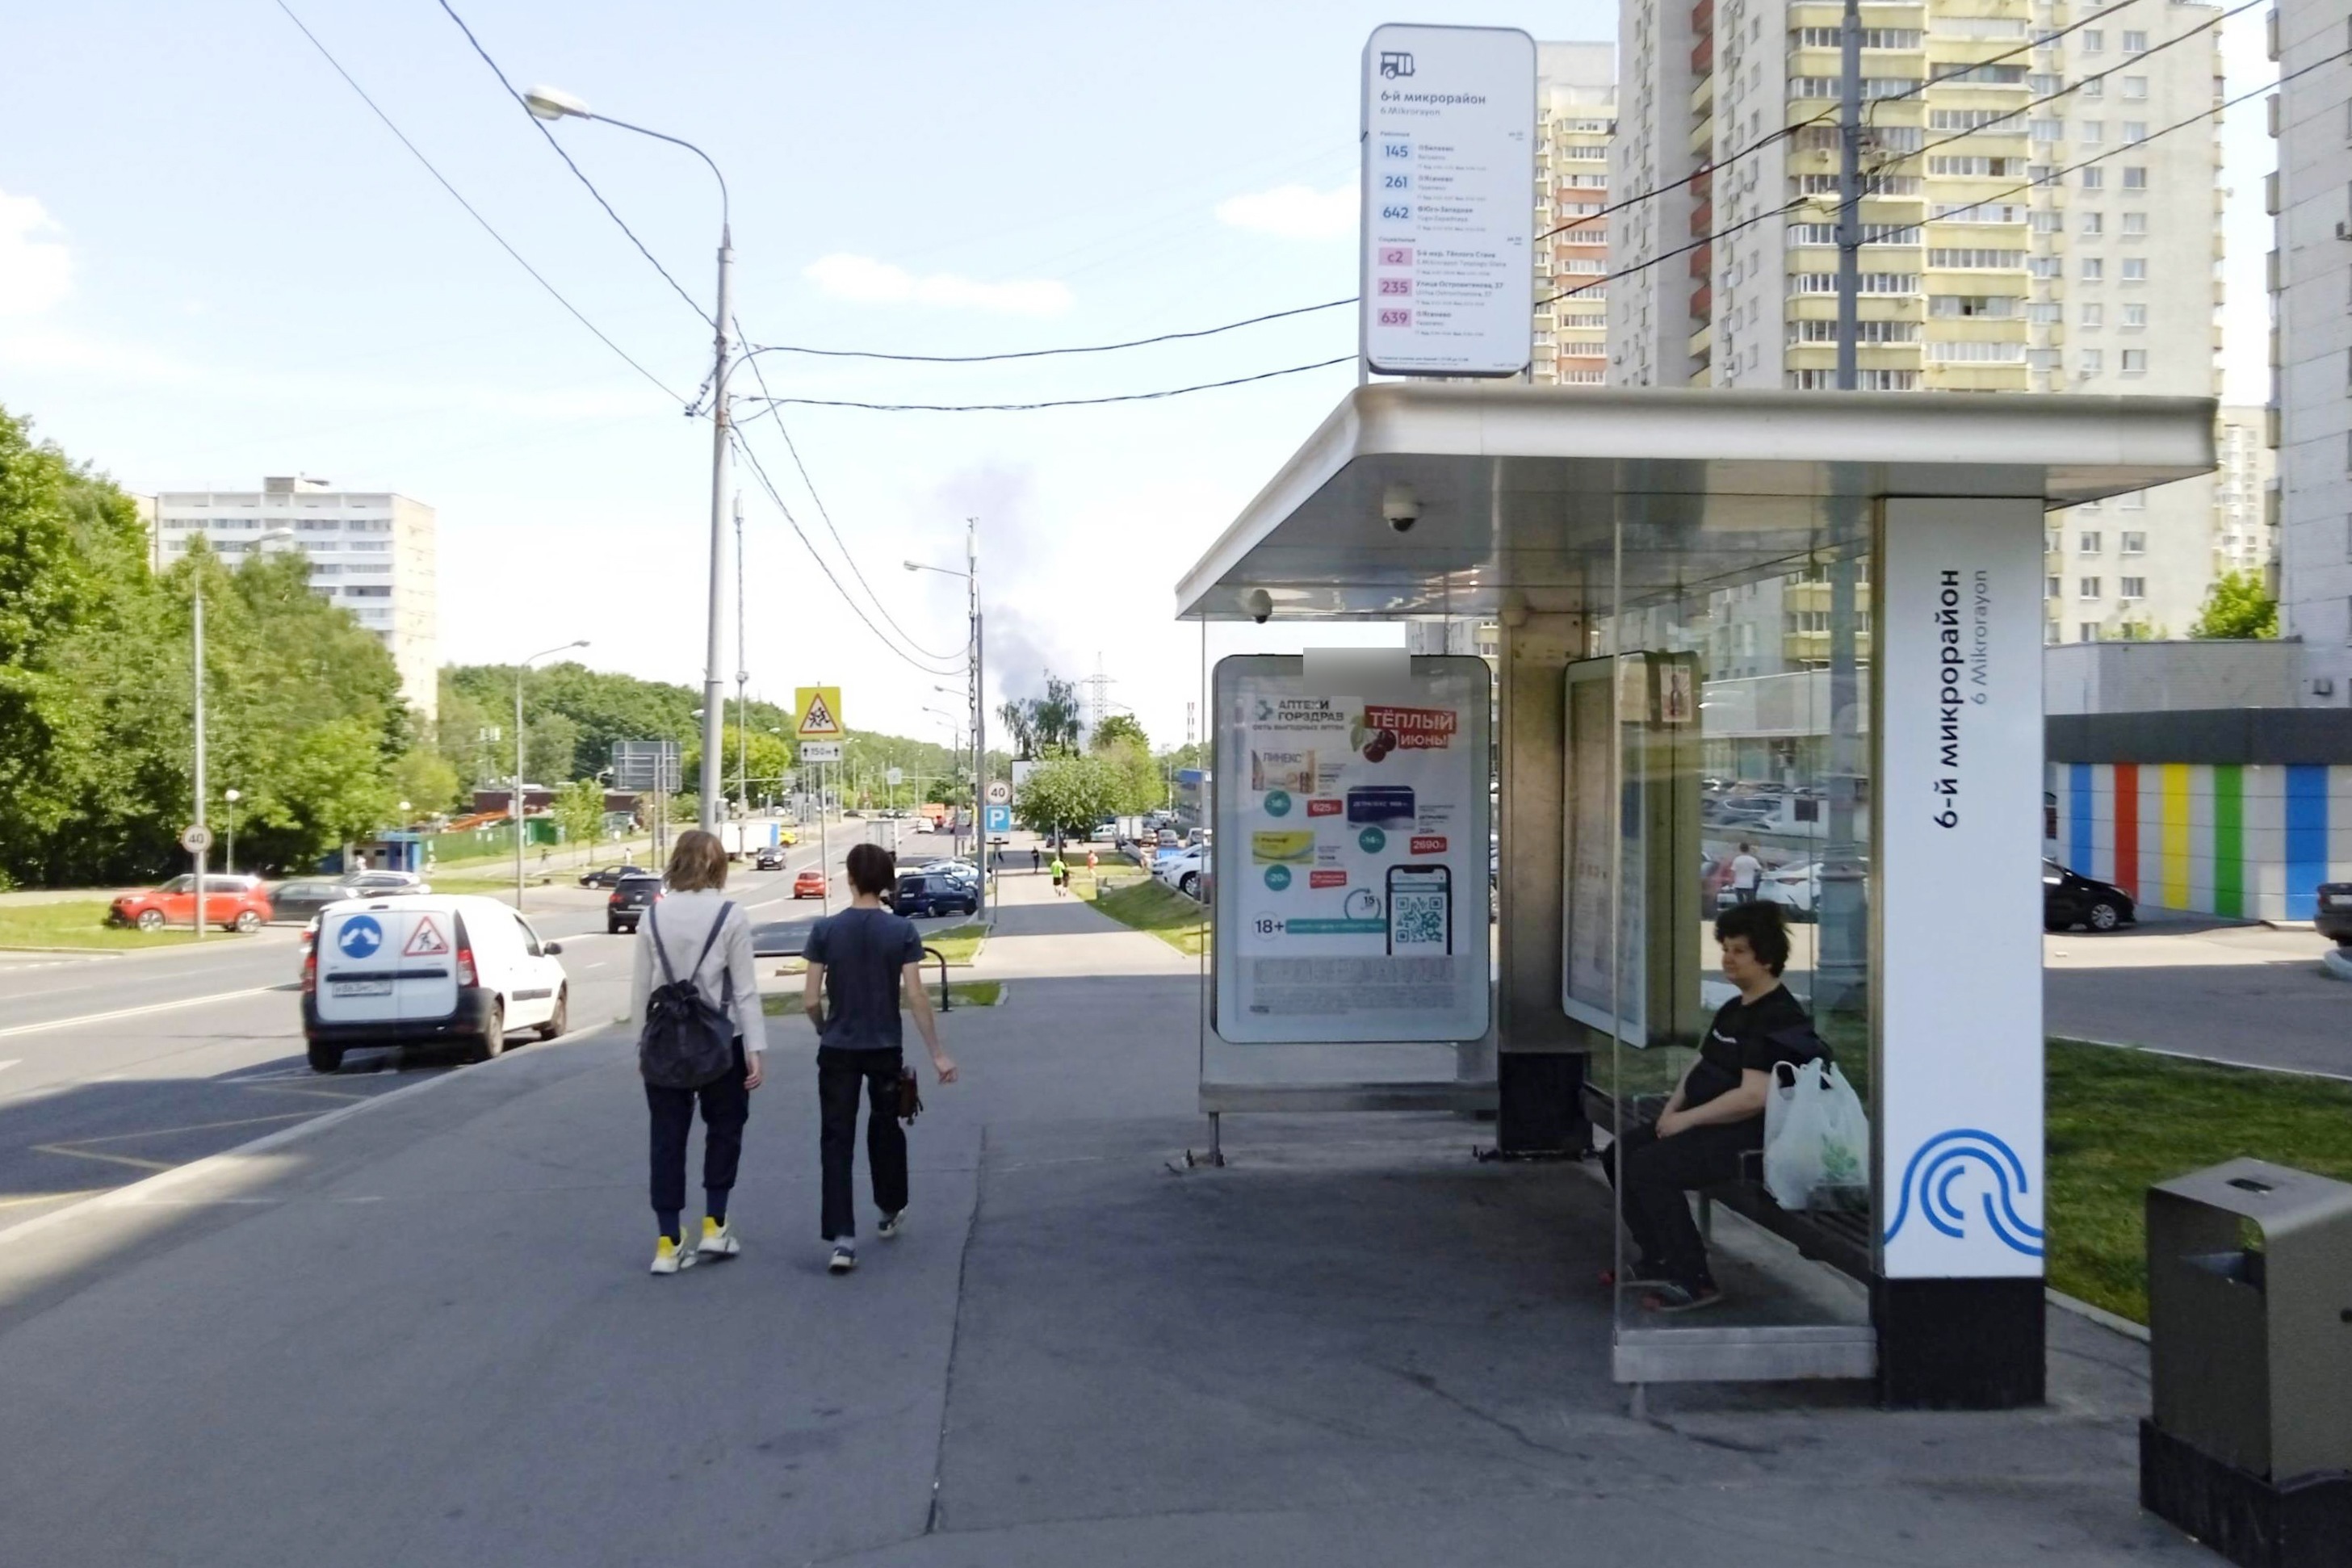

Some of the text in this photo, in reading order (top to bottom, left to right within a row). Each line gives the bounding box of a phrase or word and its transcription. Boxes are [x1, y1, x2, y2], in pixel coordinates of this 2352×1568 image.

[1381, 90, 1486, 105] 6-й микрорайон
[1386, 145, 1408, 157] 145
[1386, 176, 1407, 188] 261
[1383, 207, 1409, 219] 642
[1382, 282, 1408, 293] 235
[1381, 312, 1407, 324] 639
[1970, 570, 1991, 705] 6 Mikrorayon
[1933, 570, 1964, 828] 6-й микрорайон
[1278, 711, 1344, 723] ГОРЗДРАВ
[1369, 709, 1453, 730] ТЁПЛЫЙ
[1401, 734, 1447, 746] ИЮНЬ!
[991, 787, 1005, 798] 40
[188, 833, 204, 845] 40
[1364, 895, 1375, 905] 15
[1255, 920, 1284, 933] 18+
